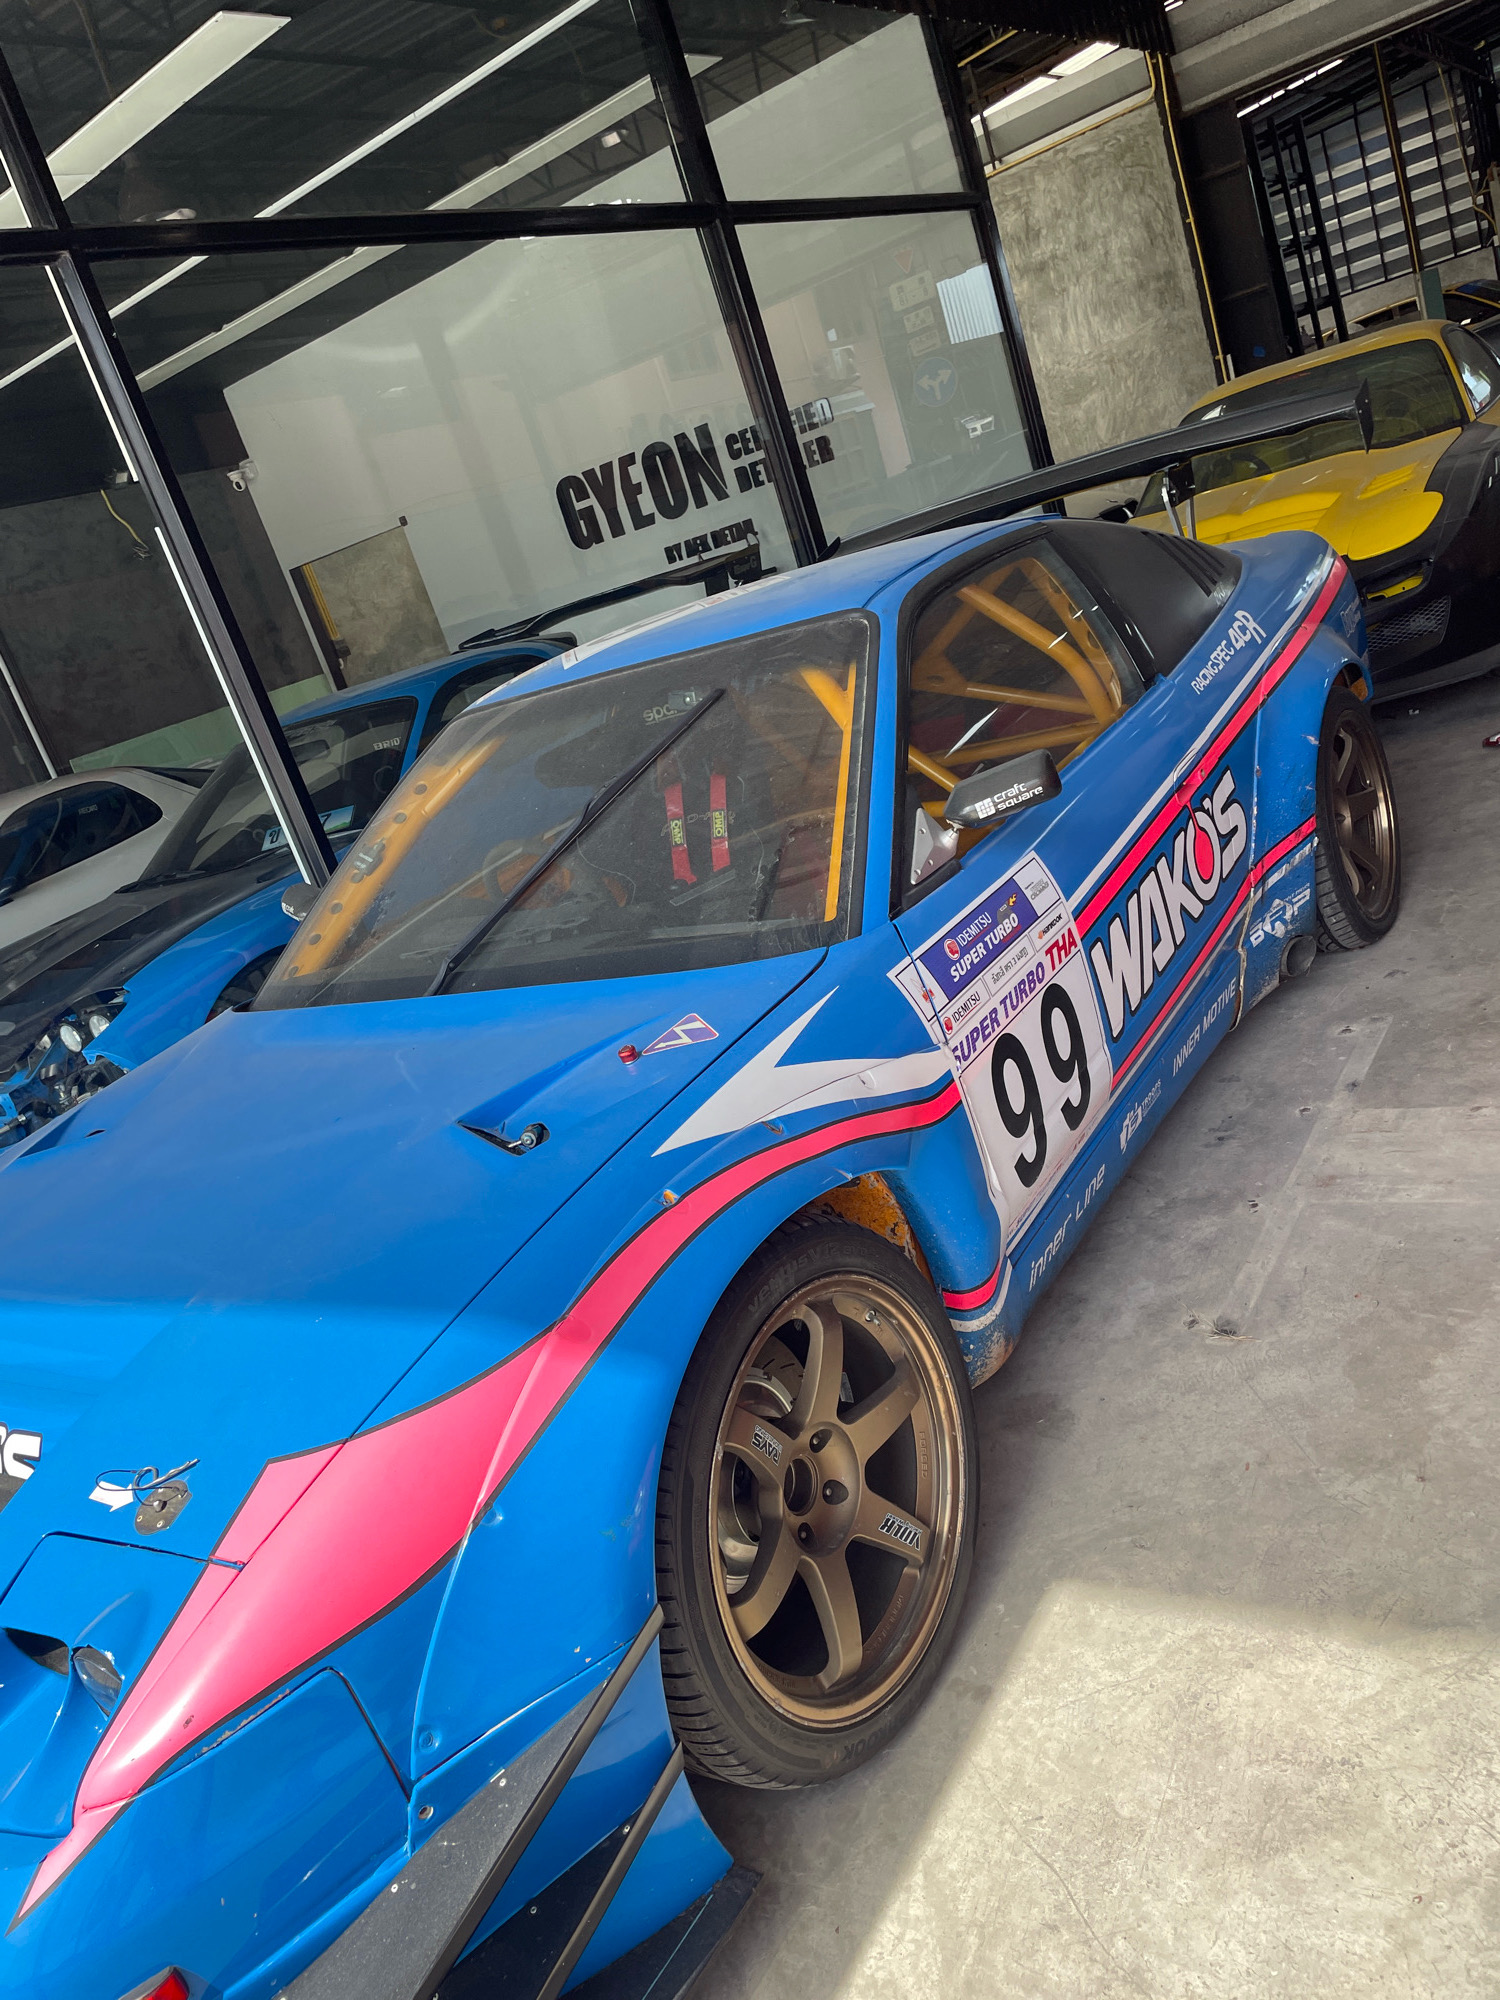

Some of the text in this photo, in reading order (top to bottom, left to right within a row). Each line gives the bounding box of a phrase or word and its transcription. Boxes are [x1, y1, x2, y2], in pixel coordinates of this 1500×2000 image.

[556, 423, 730, 550] GYEON
[664, 543, 683, 564] BY
[1228, 610, 1267, 650] 4CR
[993, 783, 1027, 803] craft
[997, 785, 1044, 811] square
[671, 819, 683, 845] OMP
[713, 811, 724, 838] OMP
[1091, 766, 1247, 1043] WAKO'S
[956, 911, 992, 947] IDEMITSU
[950, 913, 1019, 983] SUPER TURBO
[952, 927, 1078, 1068] SUPER TURBO THA
[952, 991, 981, 1023] IDEMITSU
[1172, 977, 1236, 1078] INNER MOTIVE
[991, 983, 1091, 1188] 99
[751, 1431, 782, 1466] RAYS
